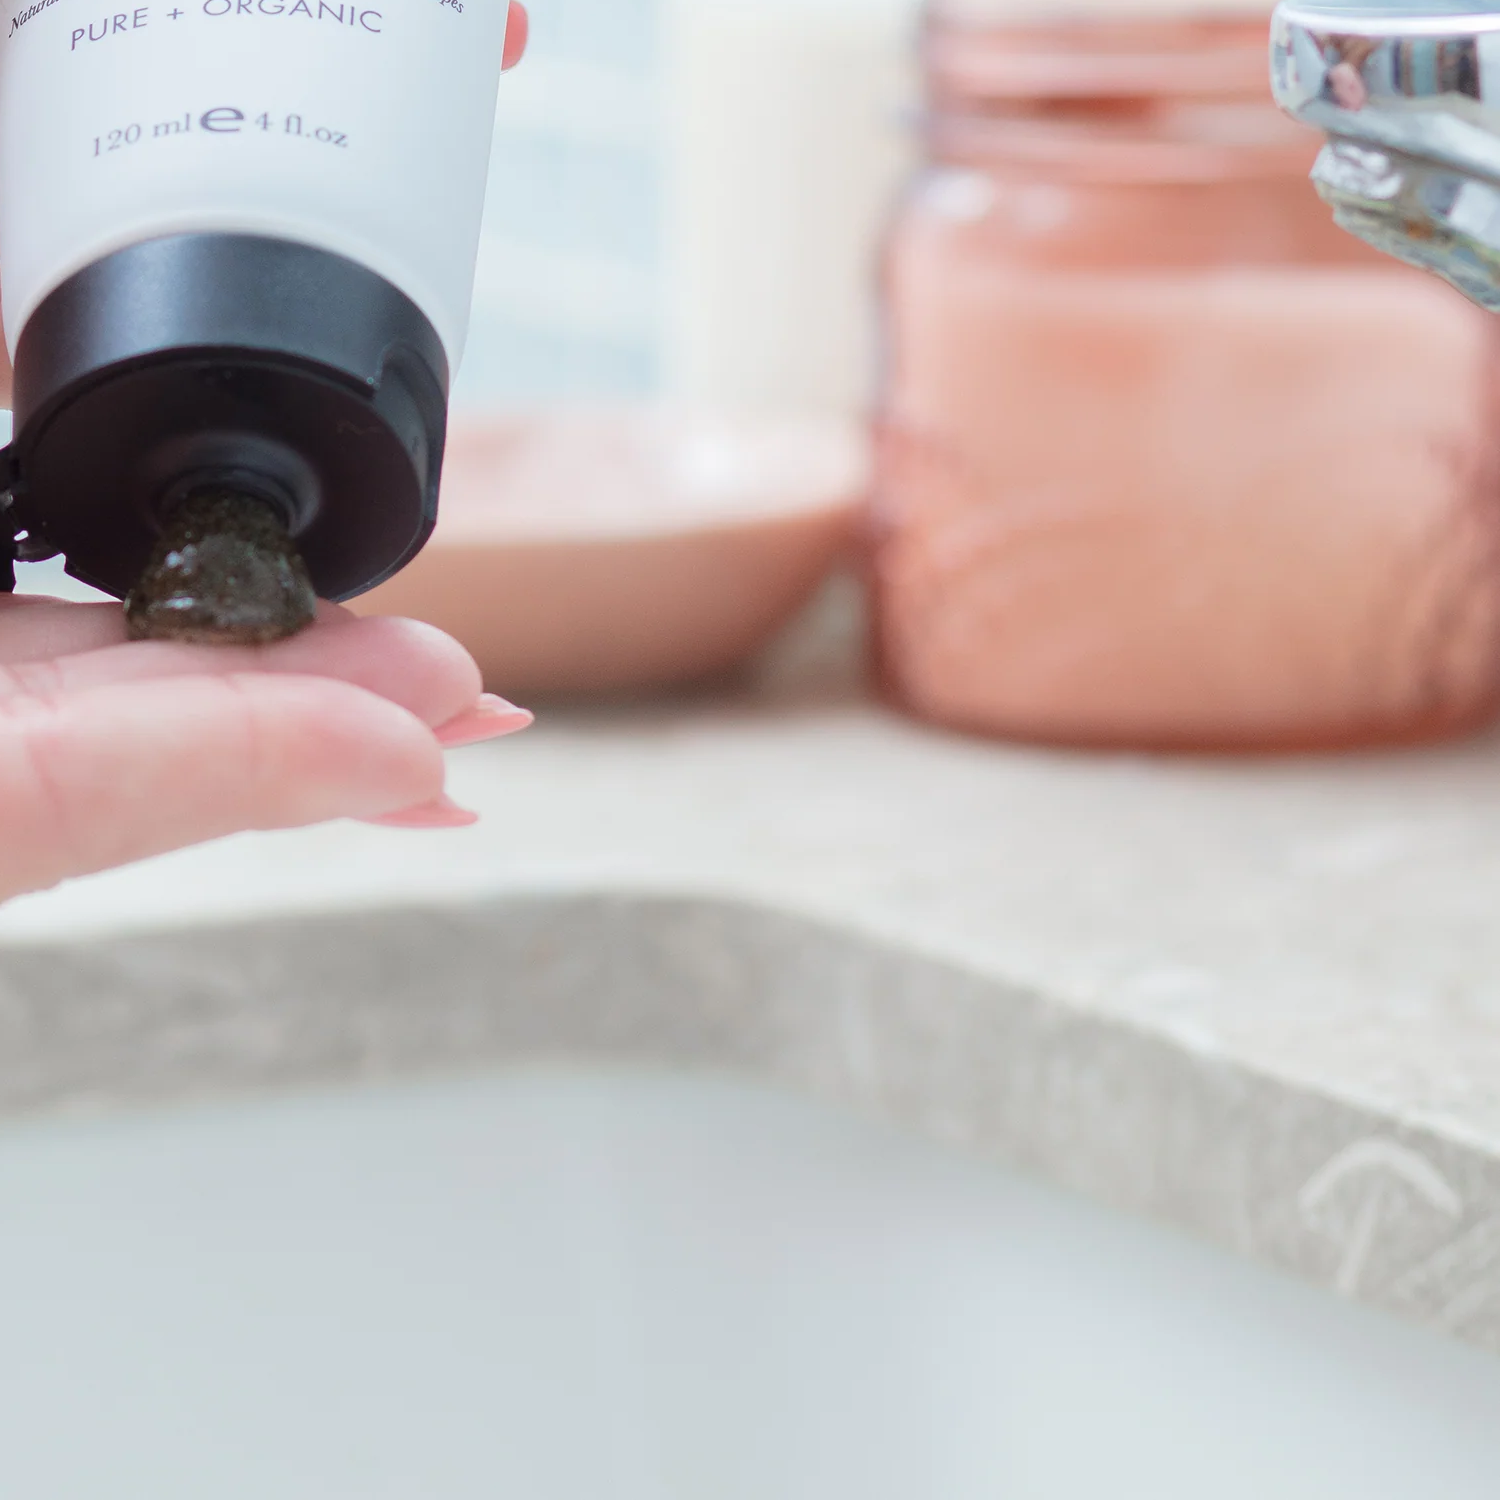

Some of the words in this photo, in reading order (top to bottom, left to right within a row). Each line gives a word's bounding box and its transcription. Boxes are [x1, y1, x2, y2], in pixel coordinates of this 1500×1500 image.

[71, 7, 149, 51] PURE
[91, 123, 143, 158] 120
[152, 112, 192, 138] ml
[255, 112, 274, 131] 4
